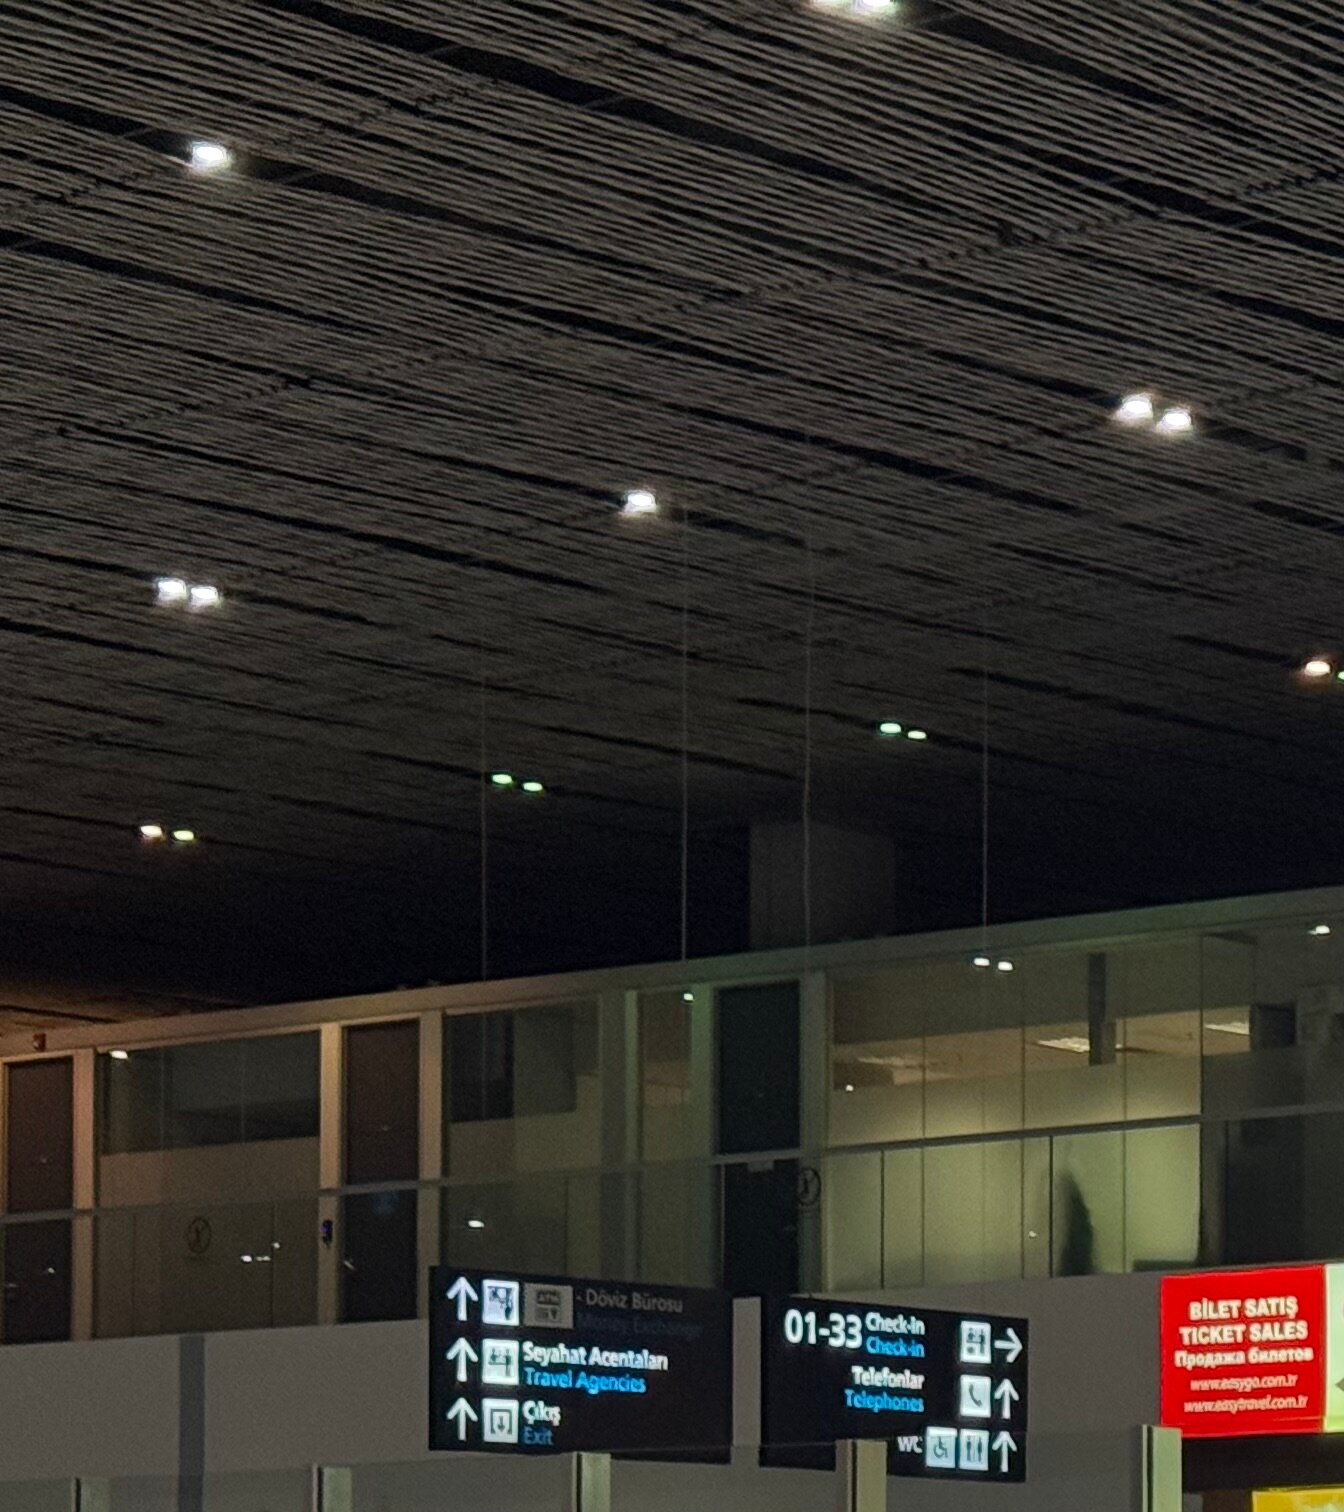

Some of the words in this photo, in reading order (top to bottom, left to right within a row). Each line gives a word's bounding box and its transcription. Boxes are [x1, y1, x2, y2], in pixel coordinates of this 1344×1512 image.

[586, 1288, 627, 1308] Döviz
[632, 1291, 683, 1314] Bürosu
[1189, 1297, 1241, 1321] BİLET
[1244, 1296, 1298, 1319] SATIŞ
[784, 1308, 862, 1349] 01-33
[865, 1312, 925, 1335] Check-in
[1179, 1324, 1246, 1346] TICKET
[1249, 1320, 1308, 1342] SALES
[522, 1341, 586, 1366] Seyahat
[589, 1347, 668, 1371] Acentaları
[865, 1336, 925, 1358] Check-in
[524, 1367, 572, 1388] Travel
[575, 1371, 646, 1394] Agencies
[851, 1365, 925, 1390] Telefonlar
[523, 1427, 553, 1446] Exit
[897, 1436, 923, 1453] WC
